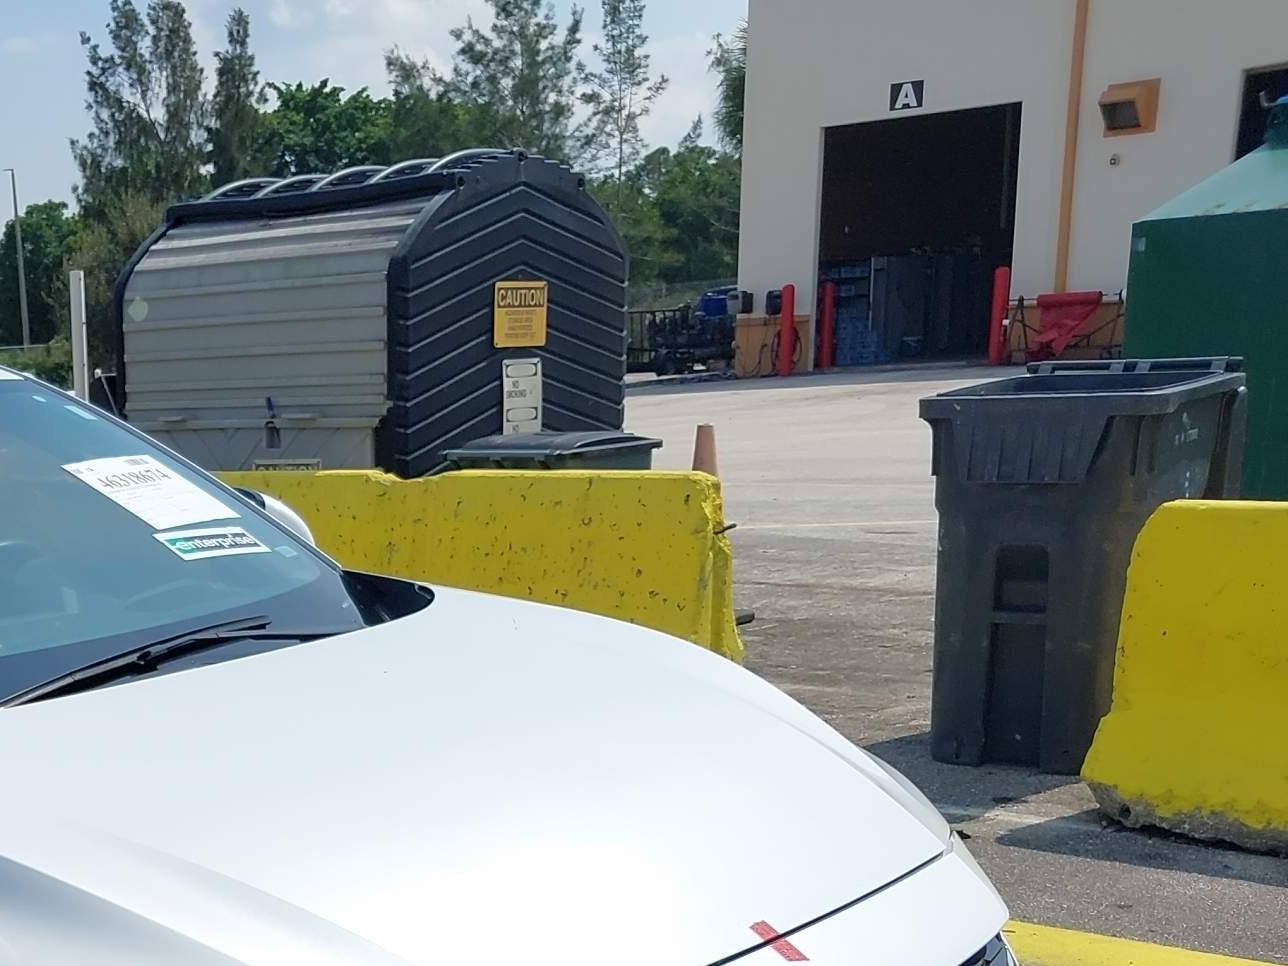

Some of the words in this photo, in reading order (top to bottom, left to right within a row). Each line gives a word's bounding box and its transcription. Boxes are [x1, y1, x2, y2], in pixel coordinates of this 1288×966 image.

[895, 83, 918, 109] A
[498, 288, 544, 306] CAUTION
[97, 468, 172, 489] 46318674
[174, 533, 257, 551] enterprise
